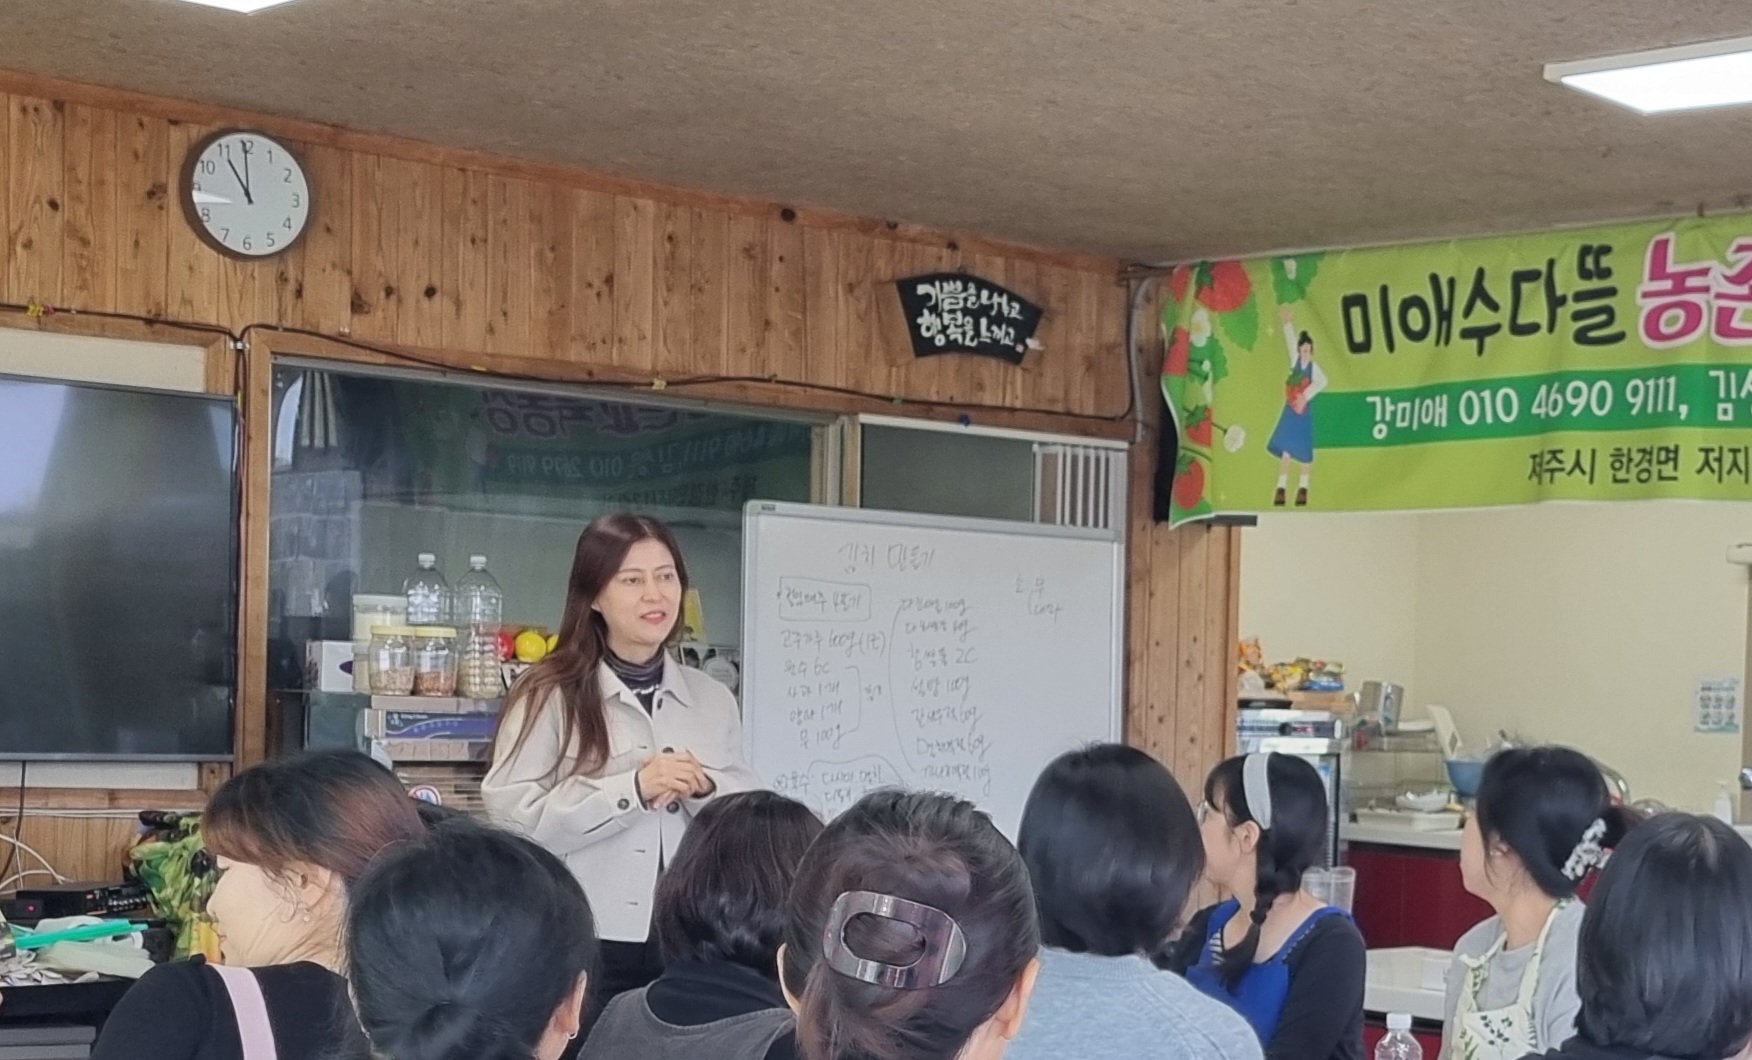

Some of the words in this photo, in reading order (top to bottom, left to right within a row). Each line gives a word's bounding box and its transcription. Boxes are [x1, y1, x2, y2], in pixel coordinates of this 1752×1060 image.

[217, 144, 231, 159] 11
[267, 149, 273, 165] 1
[200, 160, 216, 175] 10
[283, 168, 293, 184] 2
[291, 193, 300, 209] 3
[201, 207, 211, 223] 8
[283, 217, 292, 231] 4
[220, 228, 230, 243] 7
[242, 236, 252, 251] 6
[266, 232, 276, 248] 5
[1341, 244, 1627, 356] 미애수다뜰
[1365, 394, 1448, 440] 강미애
[1458, 388, 1519, 425] 010
[1530, 379, 1614, 419] 4690
[1625, 376, 1689, 420] 9111,
[1609, 443, 1680, 484] 한경면
[838, 542, 876, 574] 김치
[887, 542, 935, 572] 만들기
